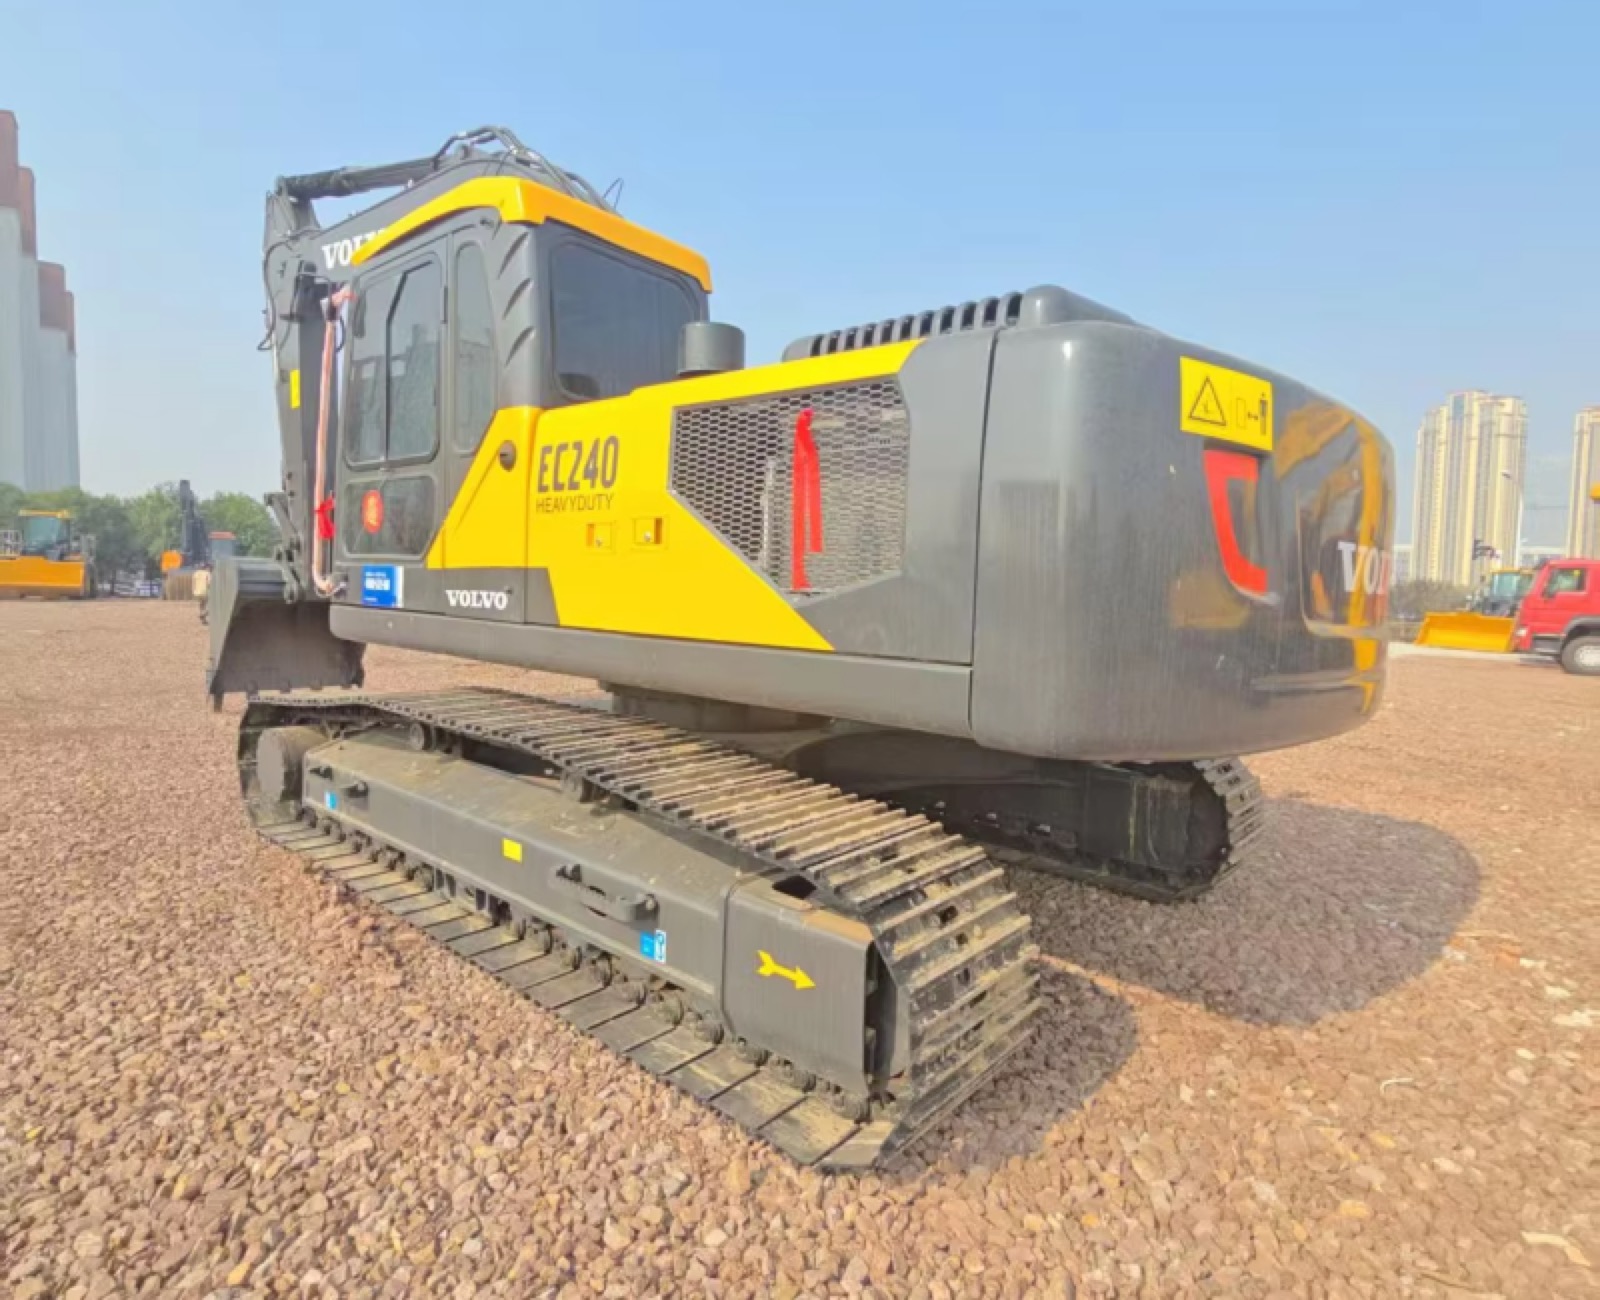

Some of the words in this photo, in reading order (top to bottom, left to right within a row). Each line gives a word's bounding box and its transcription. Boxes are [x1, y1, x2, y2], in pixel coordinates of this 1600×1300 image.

[537, 435, 619, 493] EC240
[535, 493, 614, 513] HEAVYDUTY
[445, 589, 509, 610] VOLVO
